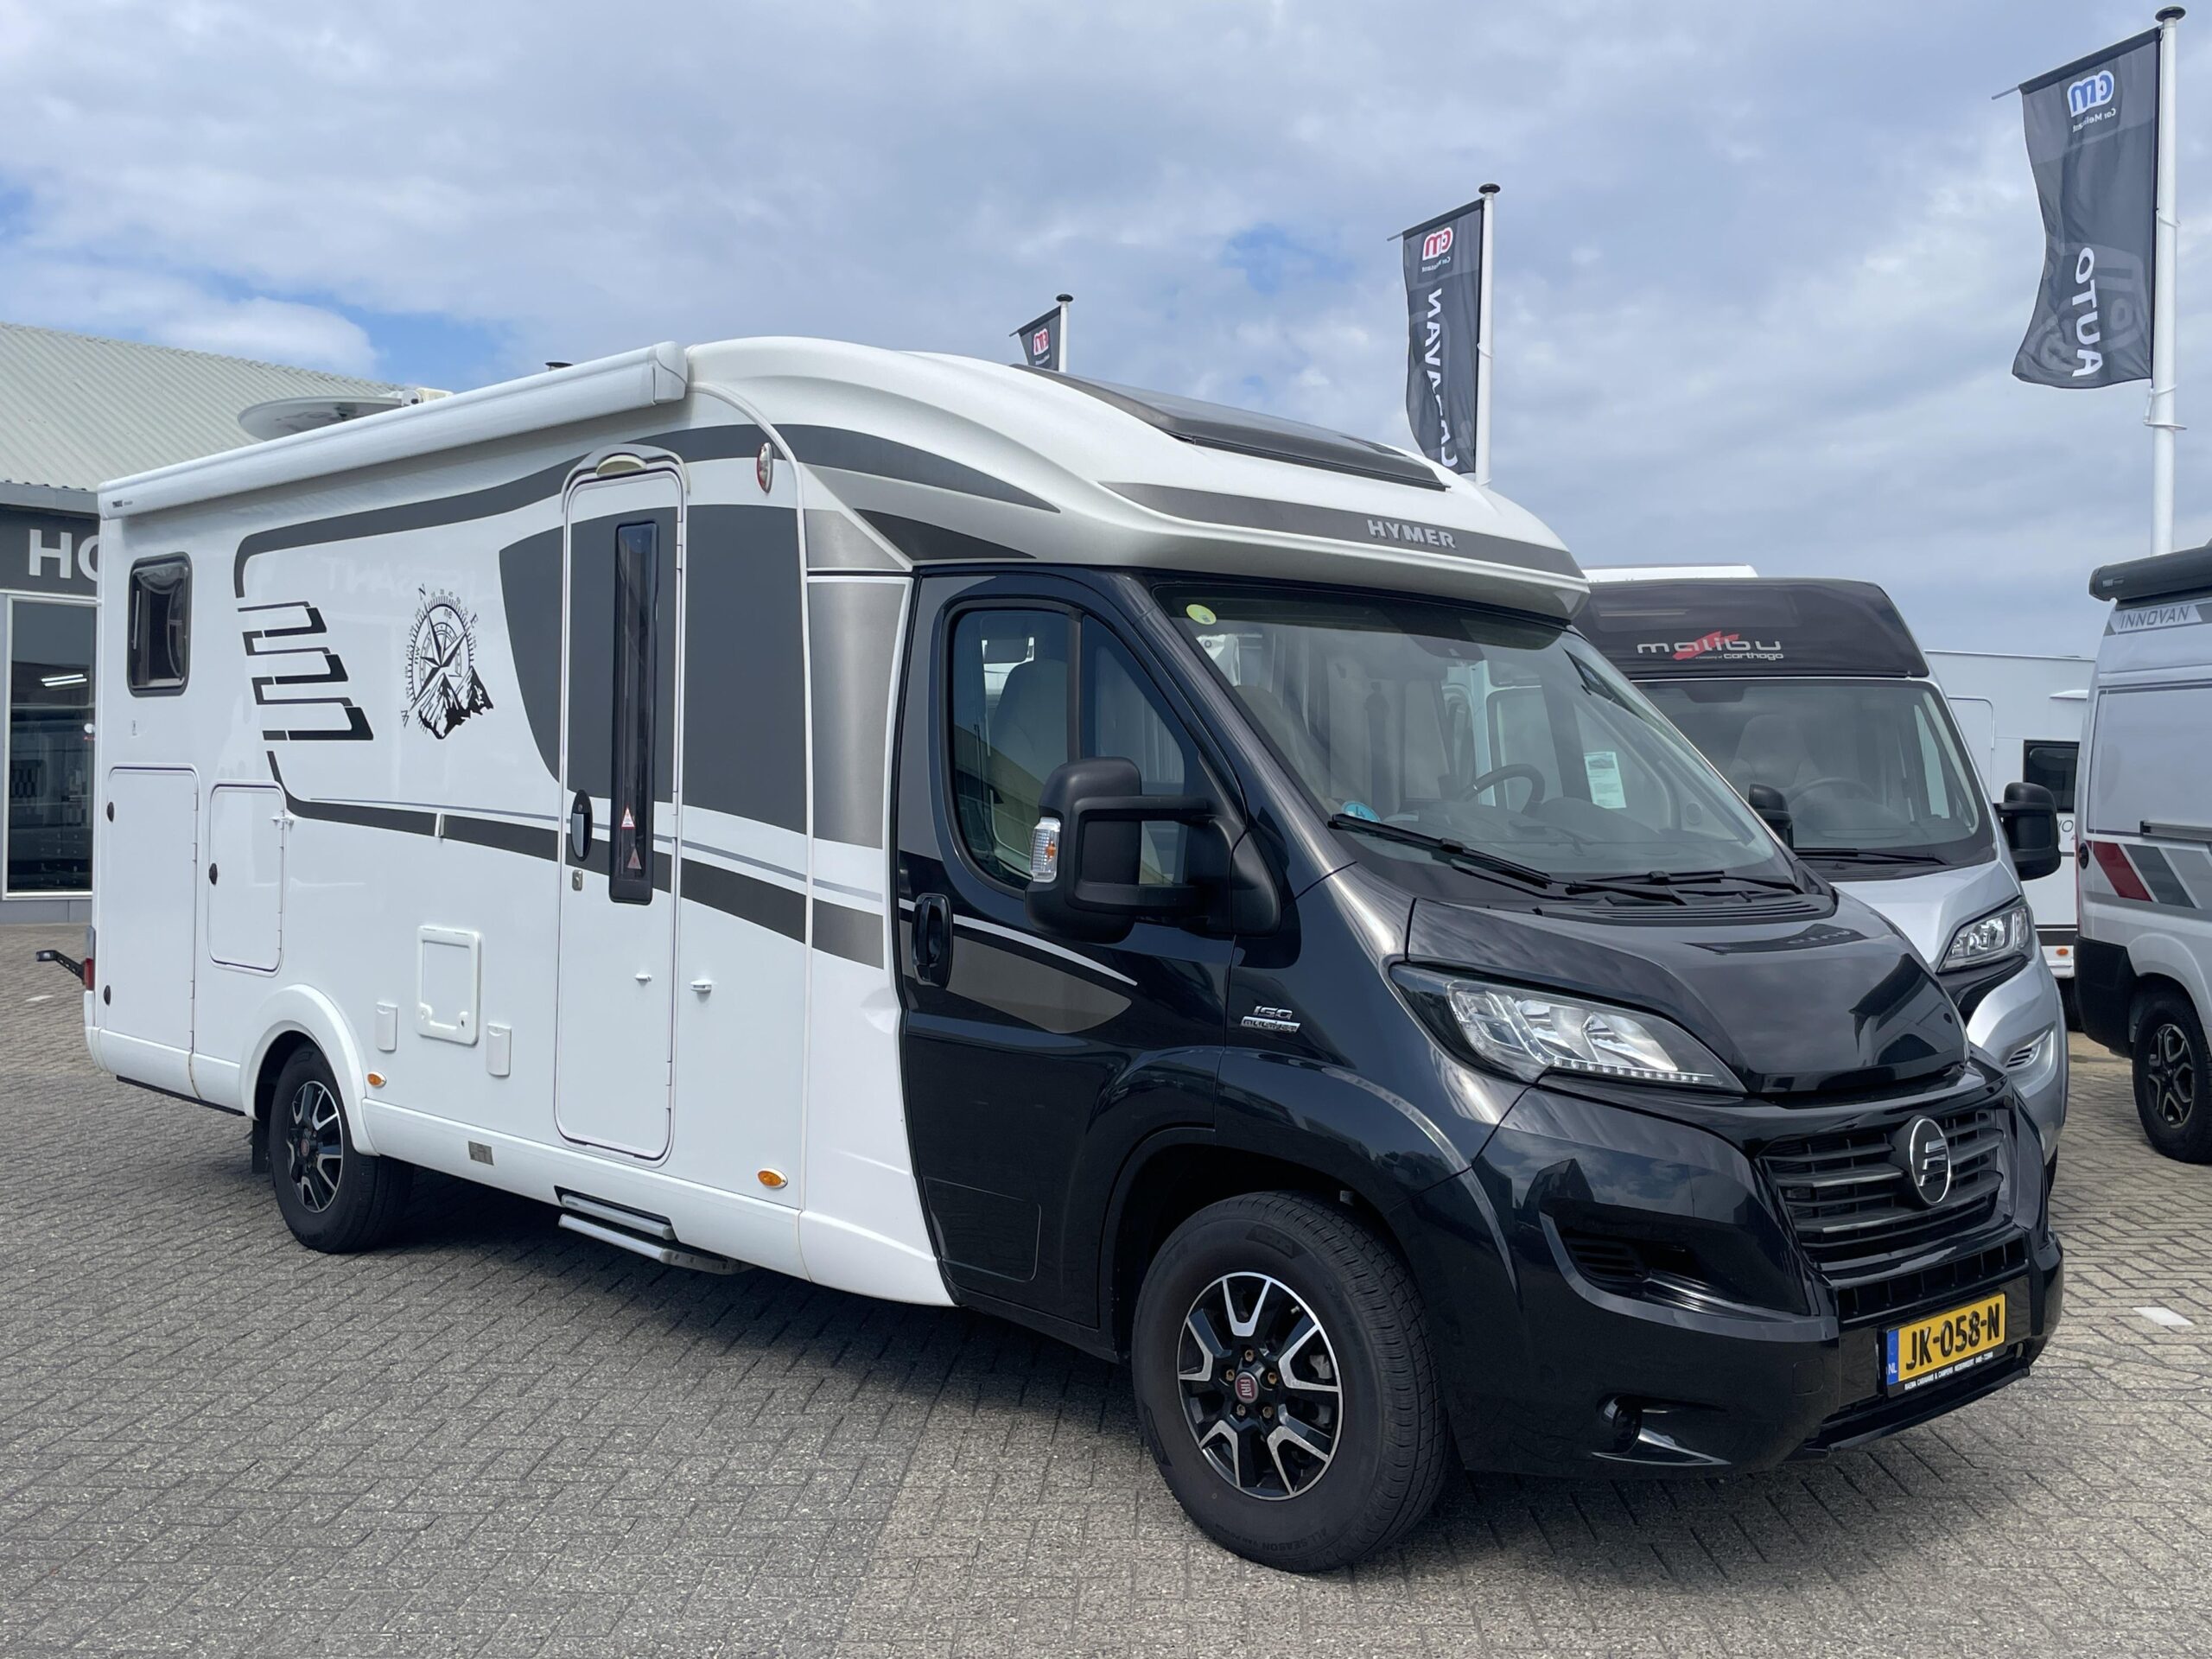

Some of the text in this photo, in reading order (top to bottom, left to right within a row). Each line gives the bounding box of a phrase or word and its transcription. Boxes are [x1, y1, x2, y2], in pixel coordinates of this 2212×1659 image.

[1367, 518, 1457, 550] HYMER
[2120, 605, 2191, 630] INNOVAN
[1637, 637, 1783, 654] malibu
[1723, 652, 1784, 662] carthago
[1253, 1005, 1294, 1020] 150
[1905, 1302, 2000, 1371] JK-058-N
[1887, 1362, 1898, 1376] NL
[1239, 1378, 1253, 1398] FIAT
